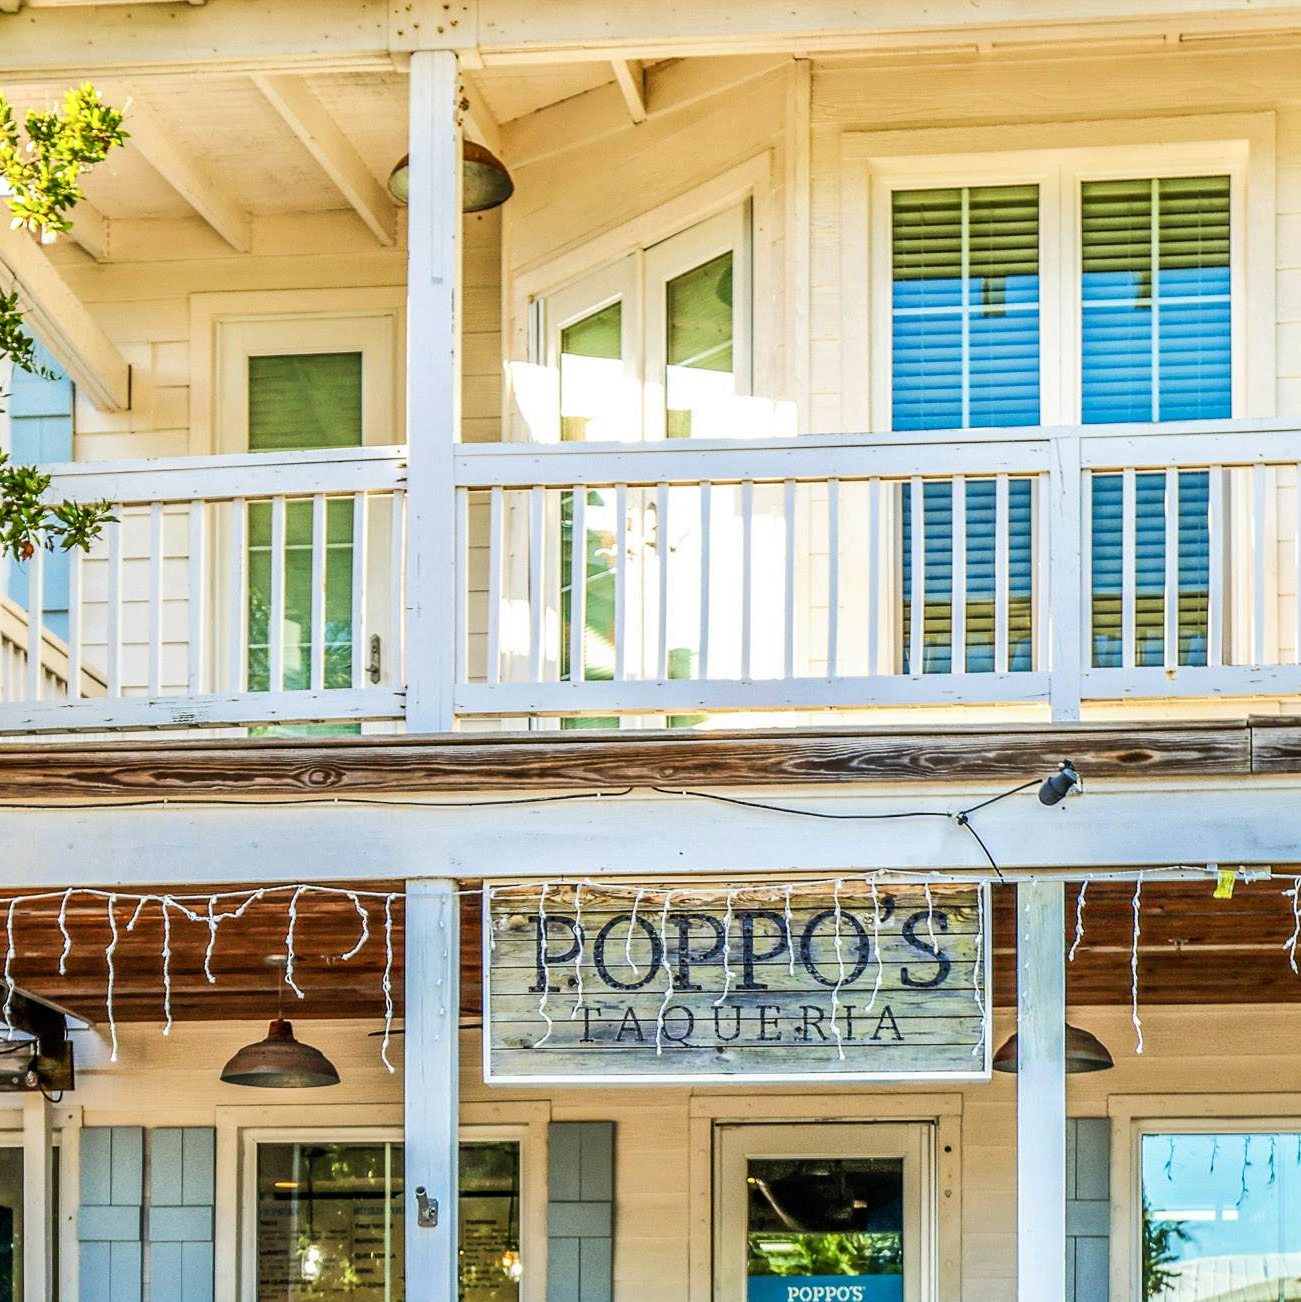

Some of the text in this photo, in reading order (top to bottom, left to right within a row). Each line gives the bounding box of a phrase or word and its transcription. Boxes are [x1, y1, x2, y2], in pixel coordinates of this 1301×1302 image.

[528, 900, 952, 993] POPPO'S
[578, 1004, 906, 1048] TAQUERIA
[787, 1286, 863, 1302] POPPO'S
